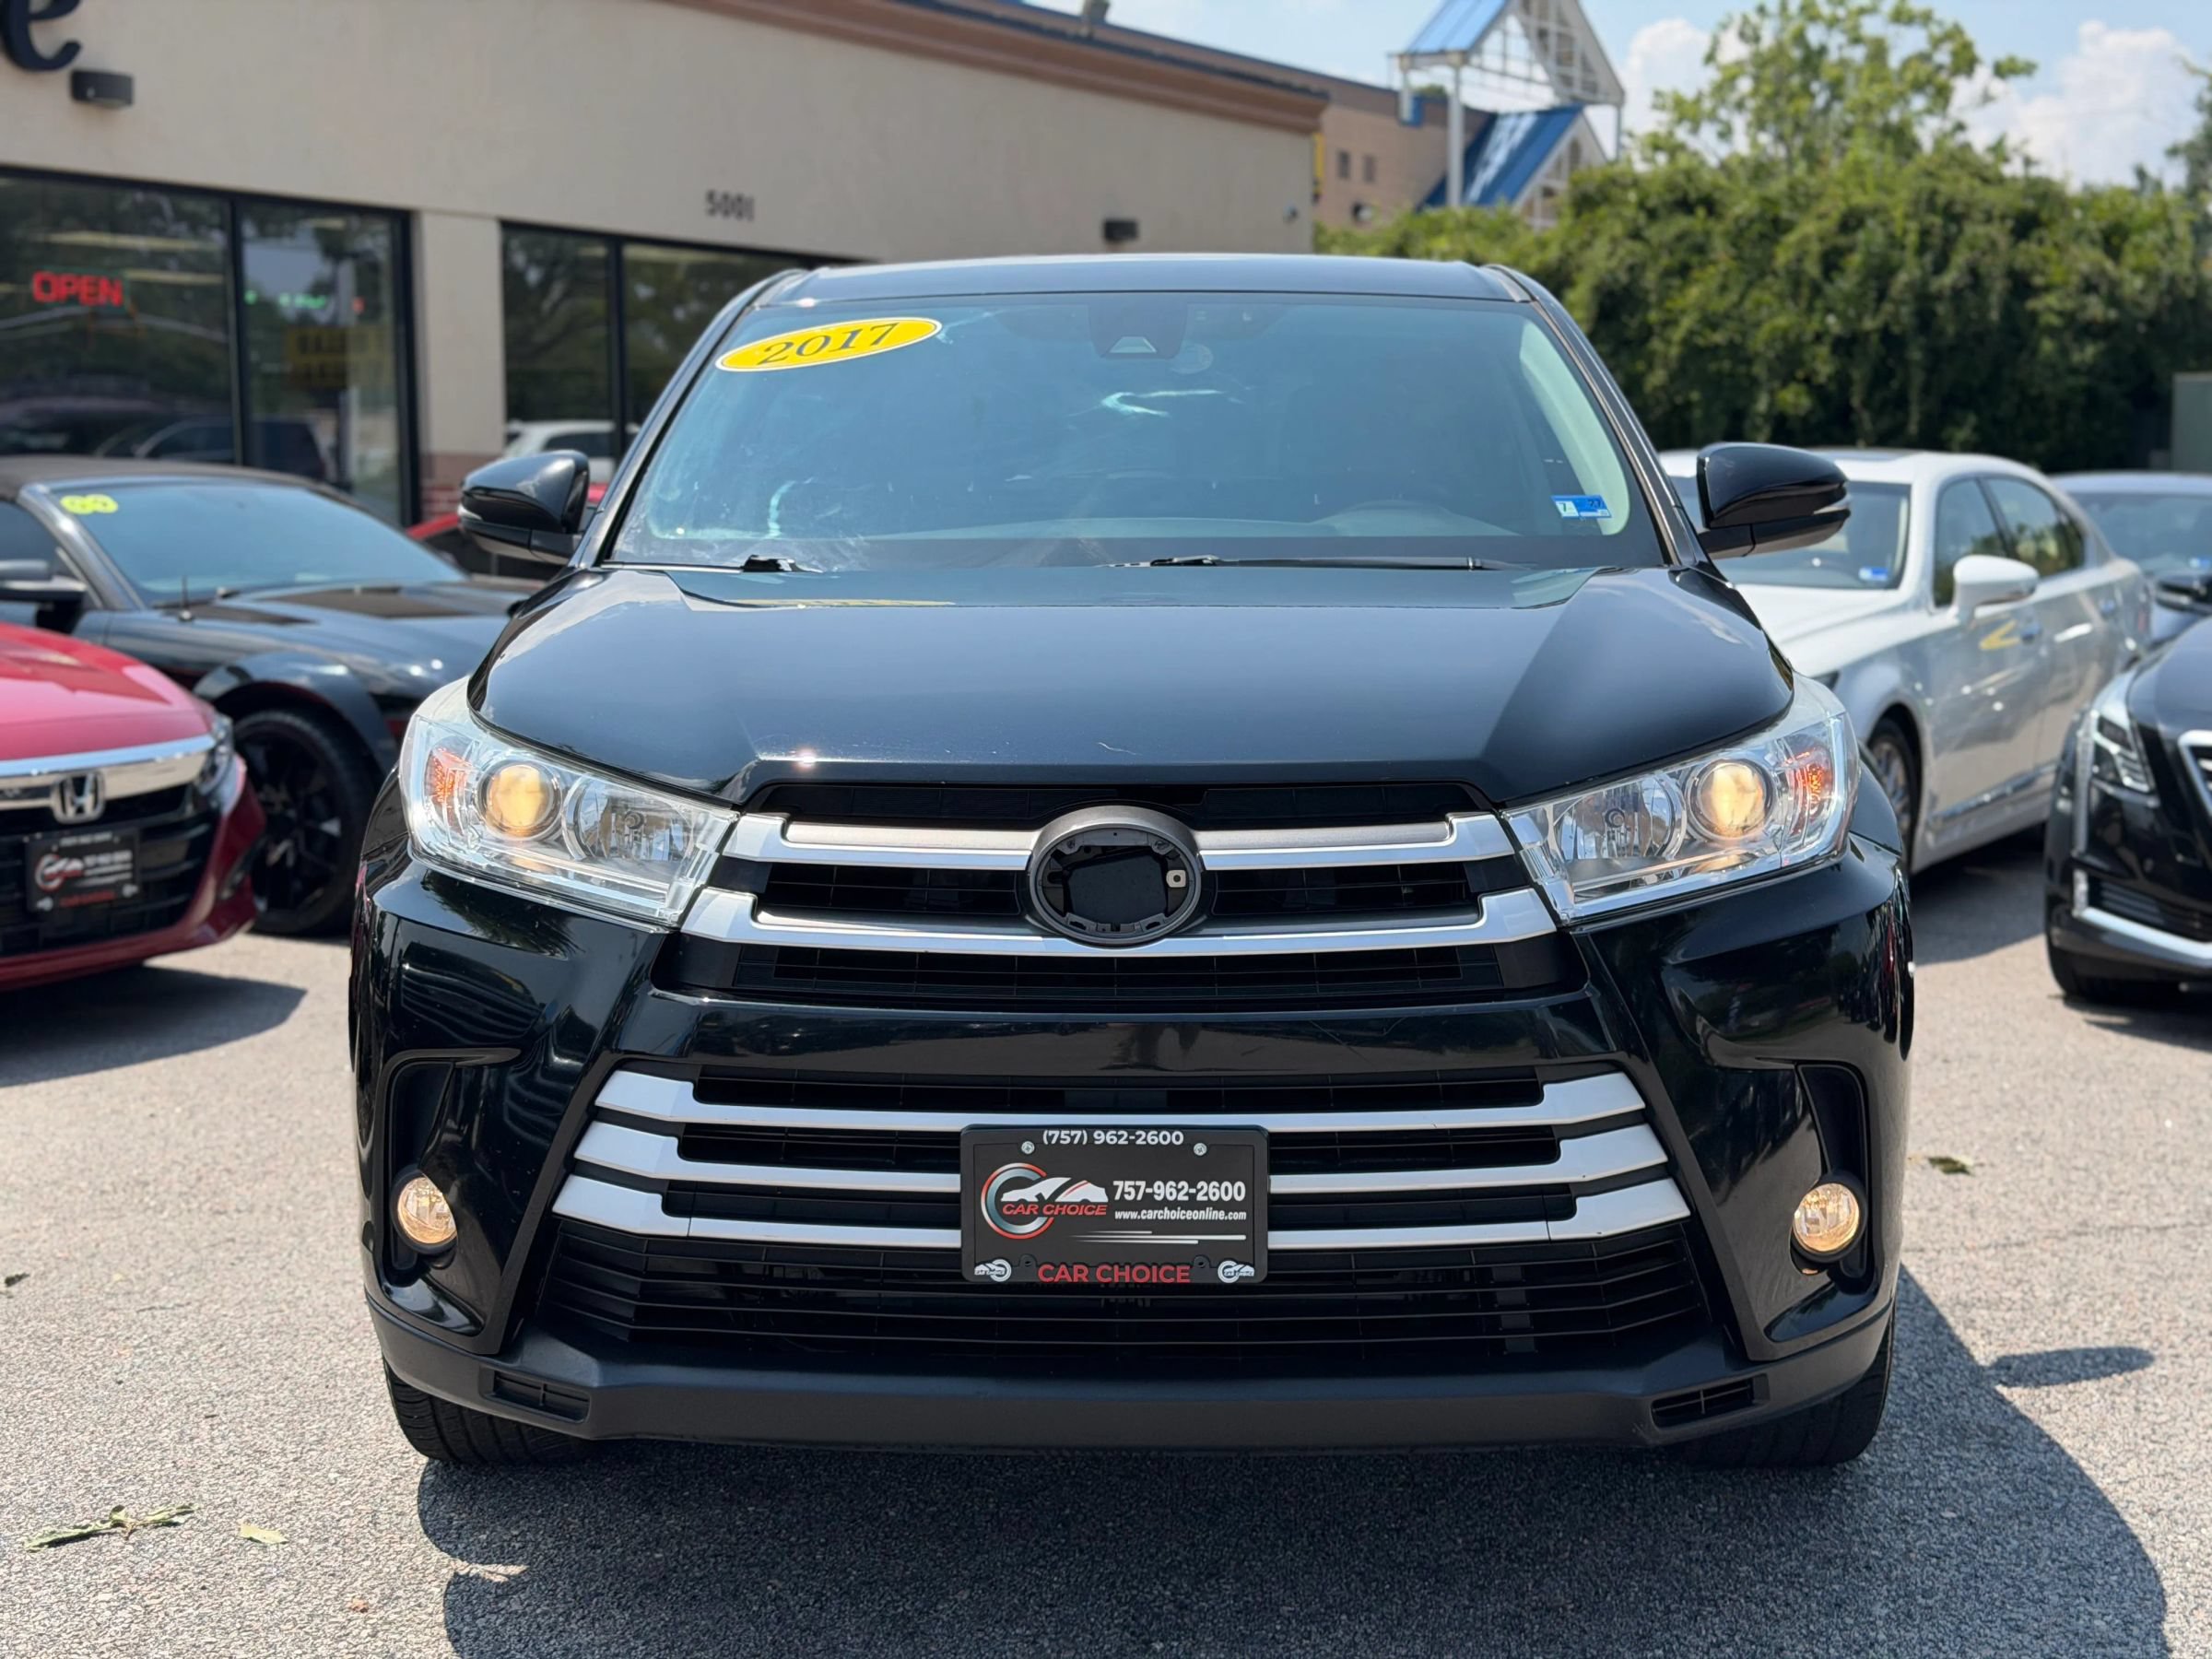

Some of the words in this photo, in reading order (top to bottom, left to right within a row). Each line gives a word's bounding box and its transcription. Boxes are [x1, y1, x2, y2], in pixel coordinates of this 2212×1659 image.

[705, 189, 755, 222] 5001
[32, 270, 124, 307] OPEN
[757, 323, 900, 365] 2017
[1042, 1129, 1088, 1146] (757)
[1093, 1130, 1184, 1146] 962-2600
[1112, 1180, 1246, 1203] 757-962-2600
[1002, 1204, 1039, 1216] CAR
[1042, 1204, 1108, 1217] CHOICE
[1114, 1206, 1247, 1221] www.carchoiceonline.com
[1038, 1264, 1089, 1283] CAR
[1096, 1265, 1191, 1284] CHOICE
